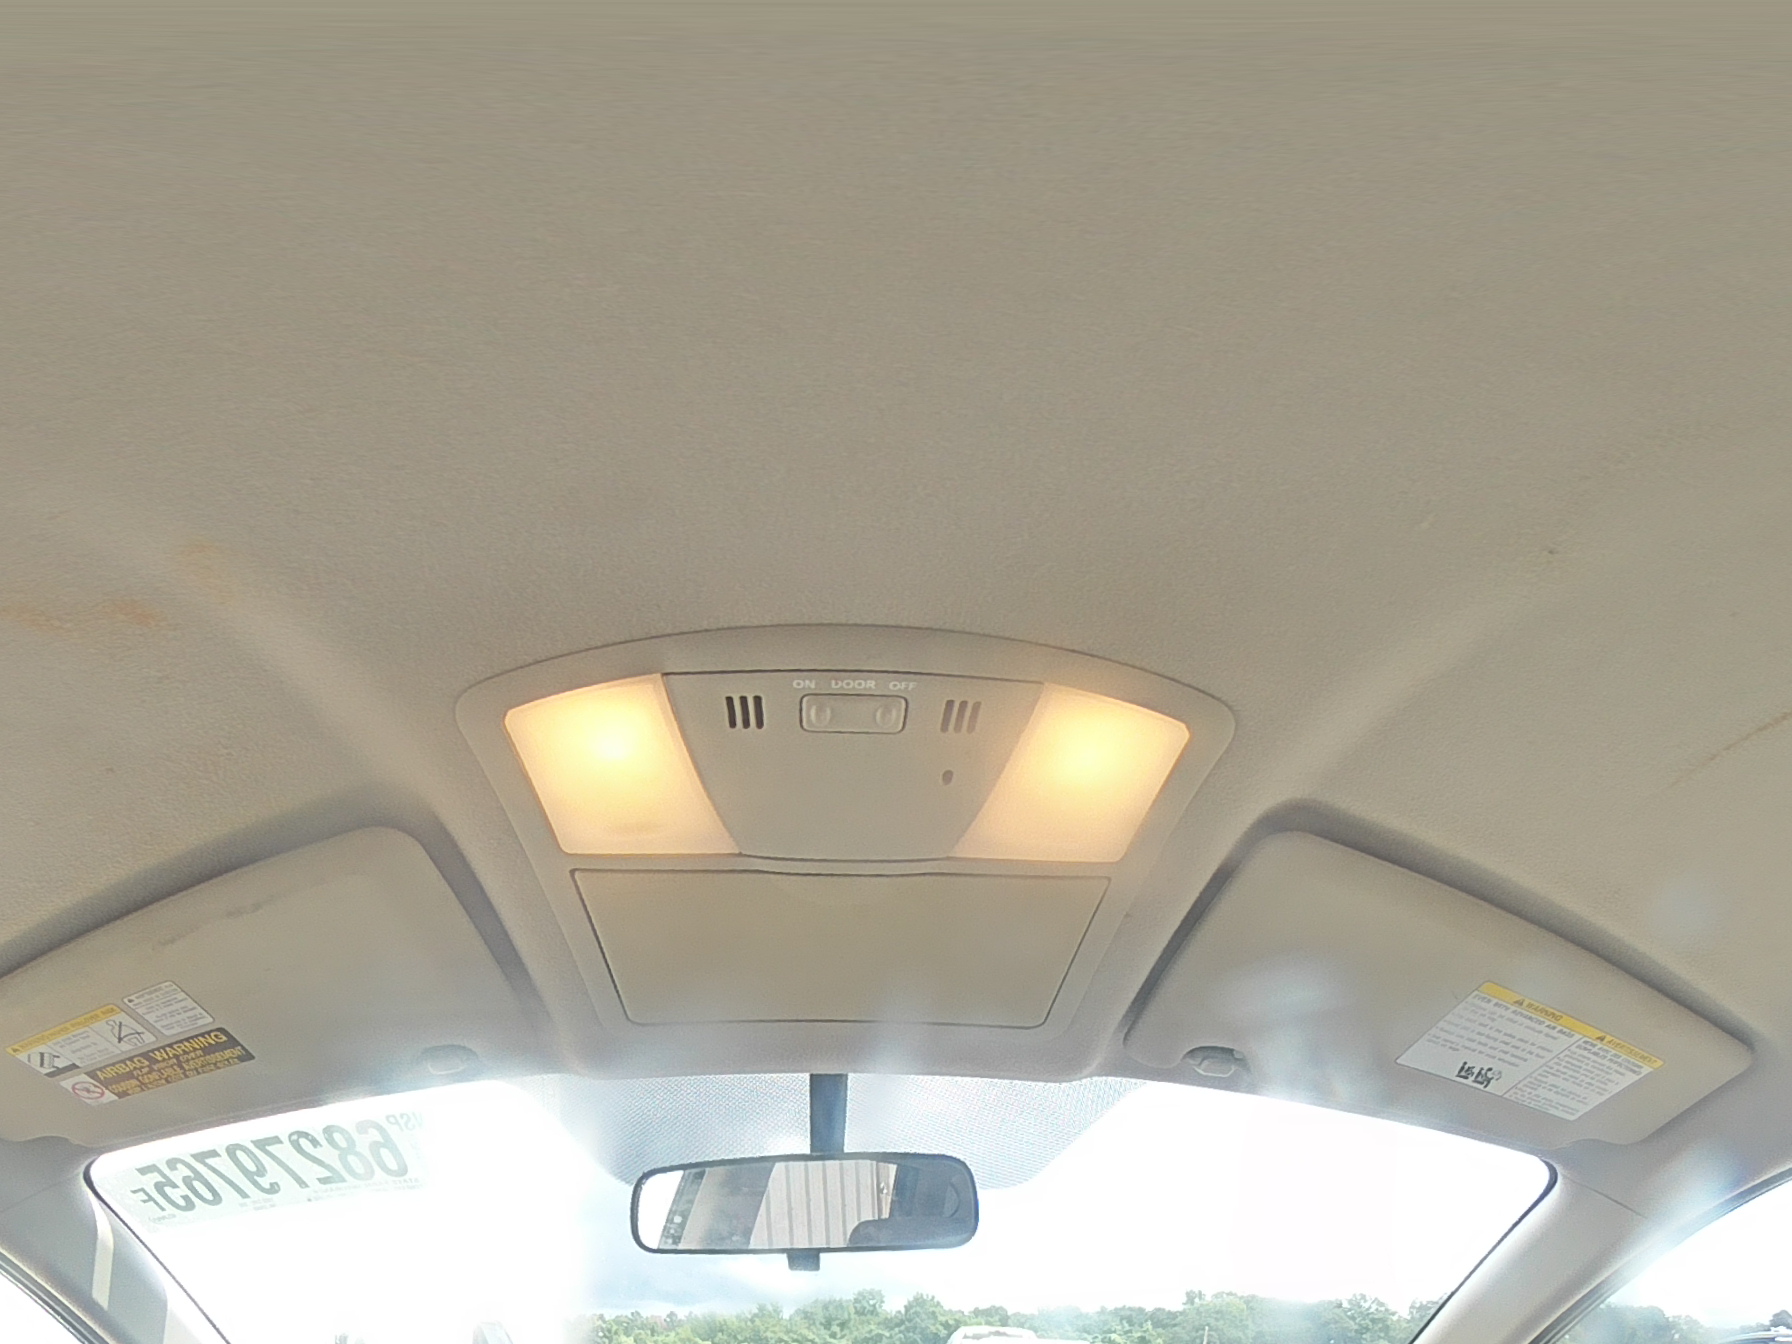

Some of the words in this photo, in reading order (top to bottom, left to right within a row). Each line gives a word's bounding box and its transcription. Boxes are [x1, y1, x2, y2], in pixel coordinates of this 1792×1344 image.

[792, 680, 816, 689] ON
[831, 680, 876, 689] DOOR
[889, 681, 918, 691] OFF
[96, 1056, 150, 1081] AIRBAG
[149, 1031, 228, 1062] WARNING
